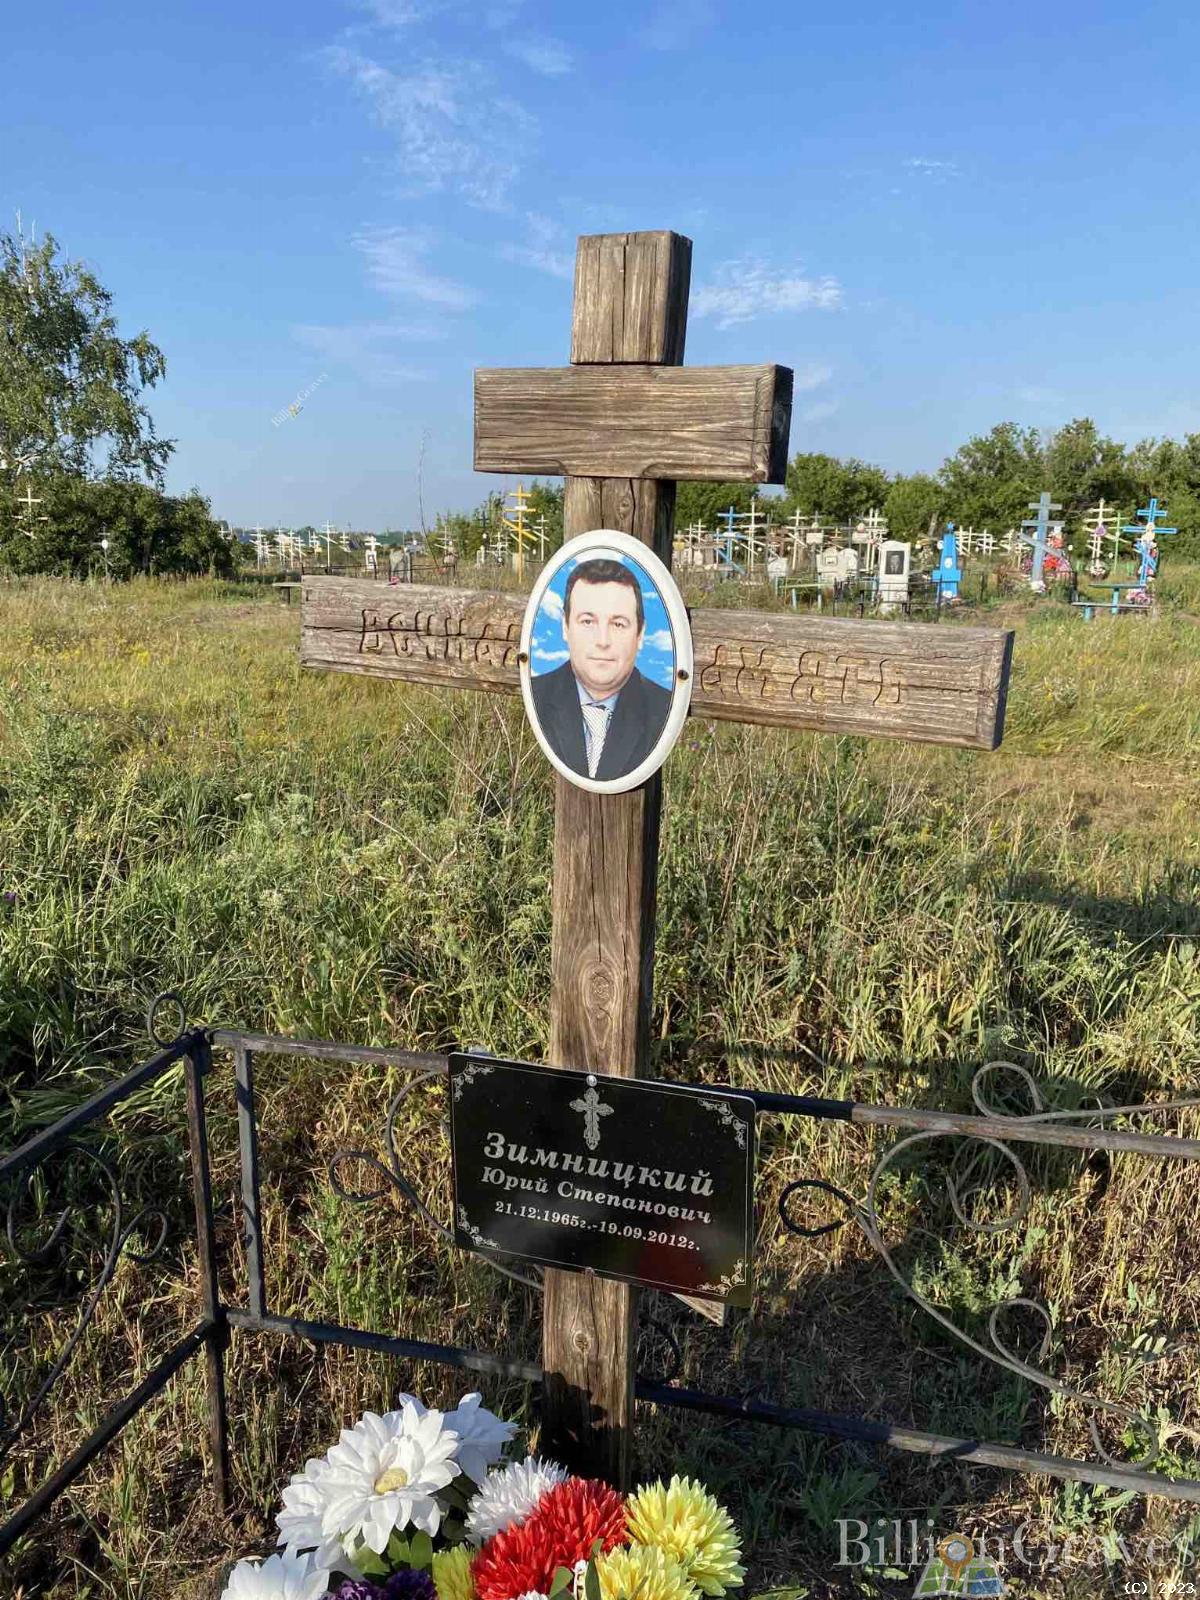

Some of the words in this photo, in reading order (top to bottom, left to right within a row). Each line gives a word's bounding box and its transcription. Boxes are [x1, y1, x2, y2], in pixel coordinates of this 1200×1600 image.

[700, 644, 902, 705] АМЯТЬ
[483, 1131, 714, 1197] Зимницкий
[482, 1166, 549, 1194] Юрий
[557, 1180, 712, 1224] Степанович
